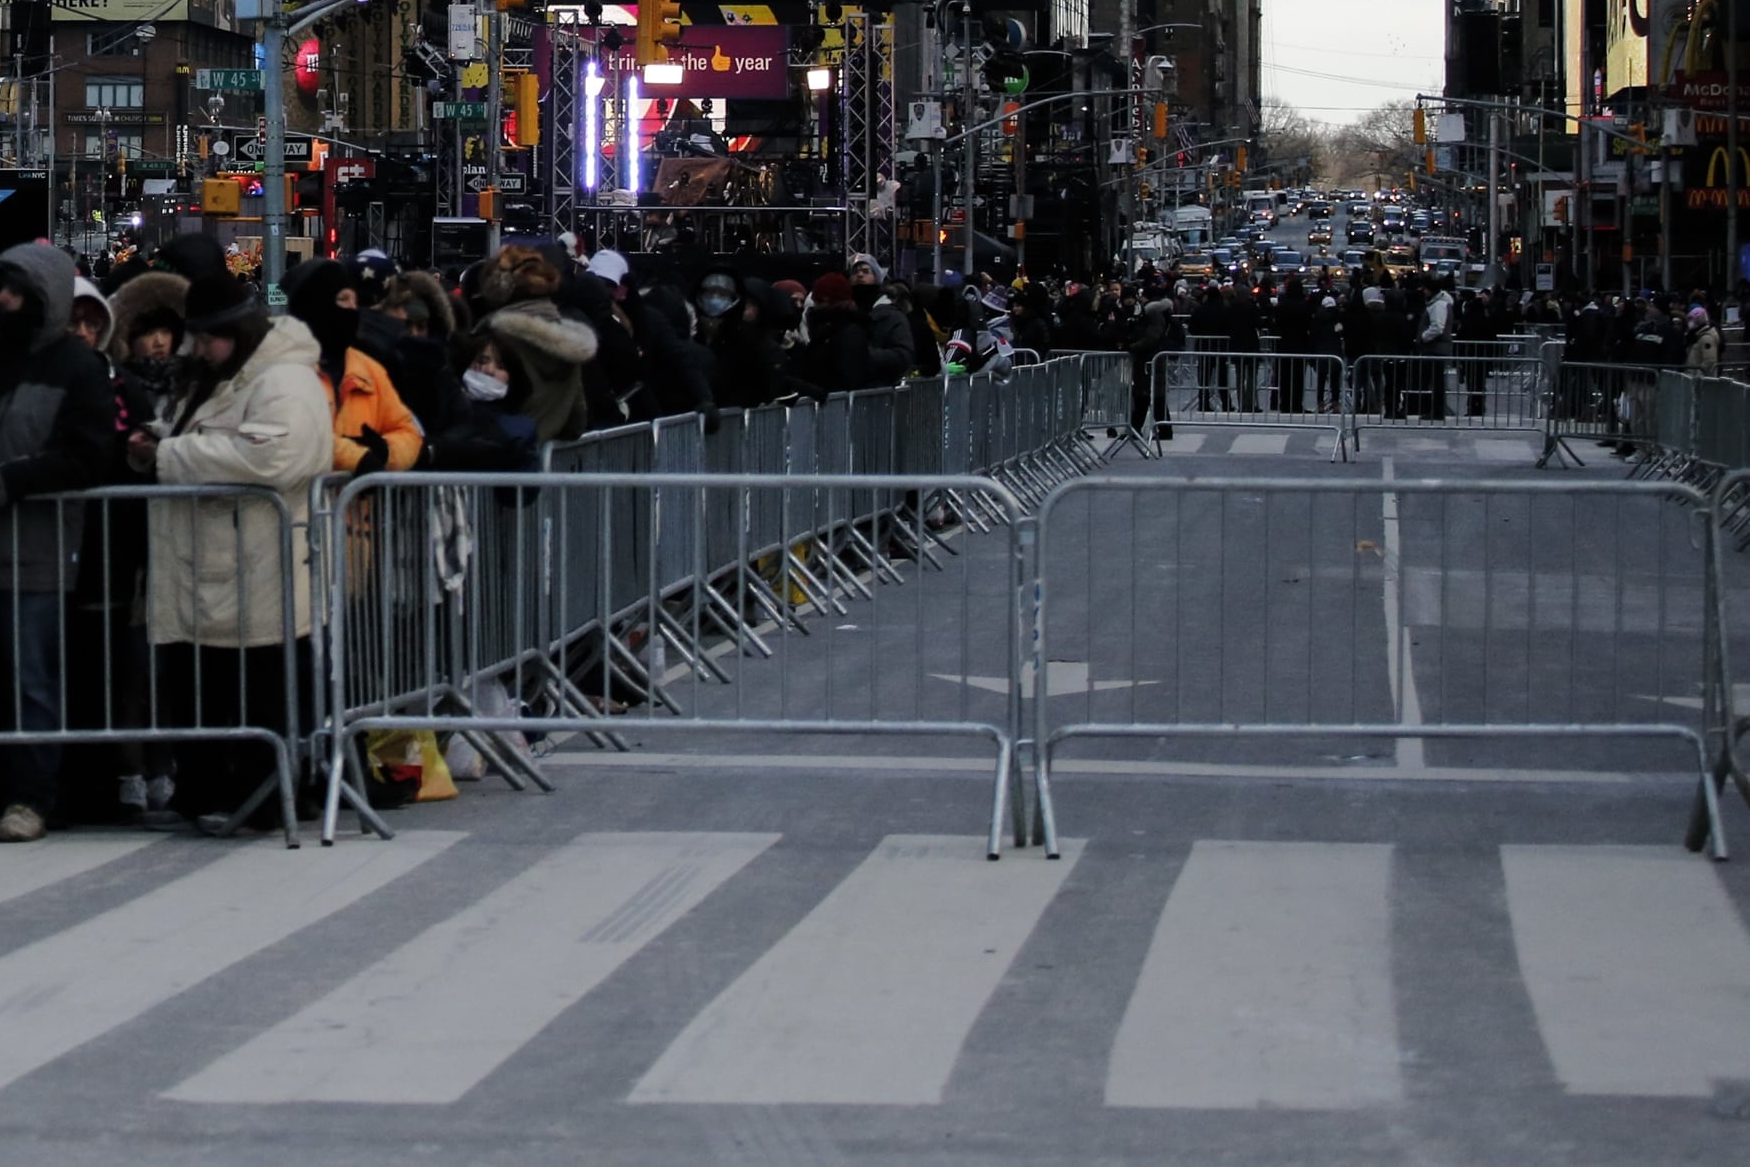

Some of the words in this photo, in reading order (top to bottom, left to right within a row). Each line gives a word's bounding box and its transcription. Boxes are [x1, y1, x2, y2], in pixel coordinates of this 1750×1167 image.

[680, 52, 707, 72] the
[734, 55, 773, 75] year
[212, 71, 226, 87] W
[230, 71, 247, 87] 45
[445, 104, 456, 117] W
[459, 104, 473, 117] 45
[473, 179, 487, 188] ON
